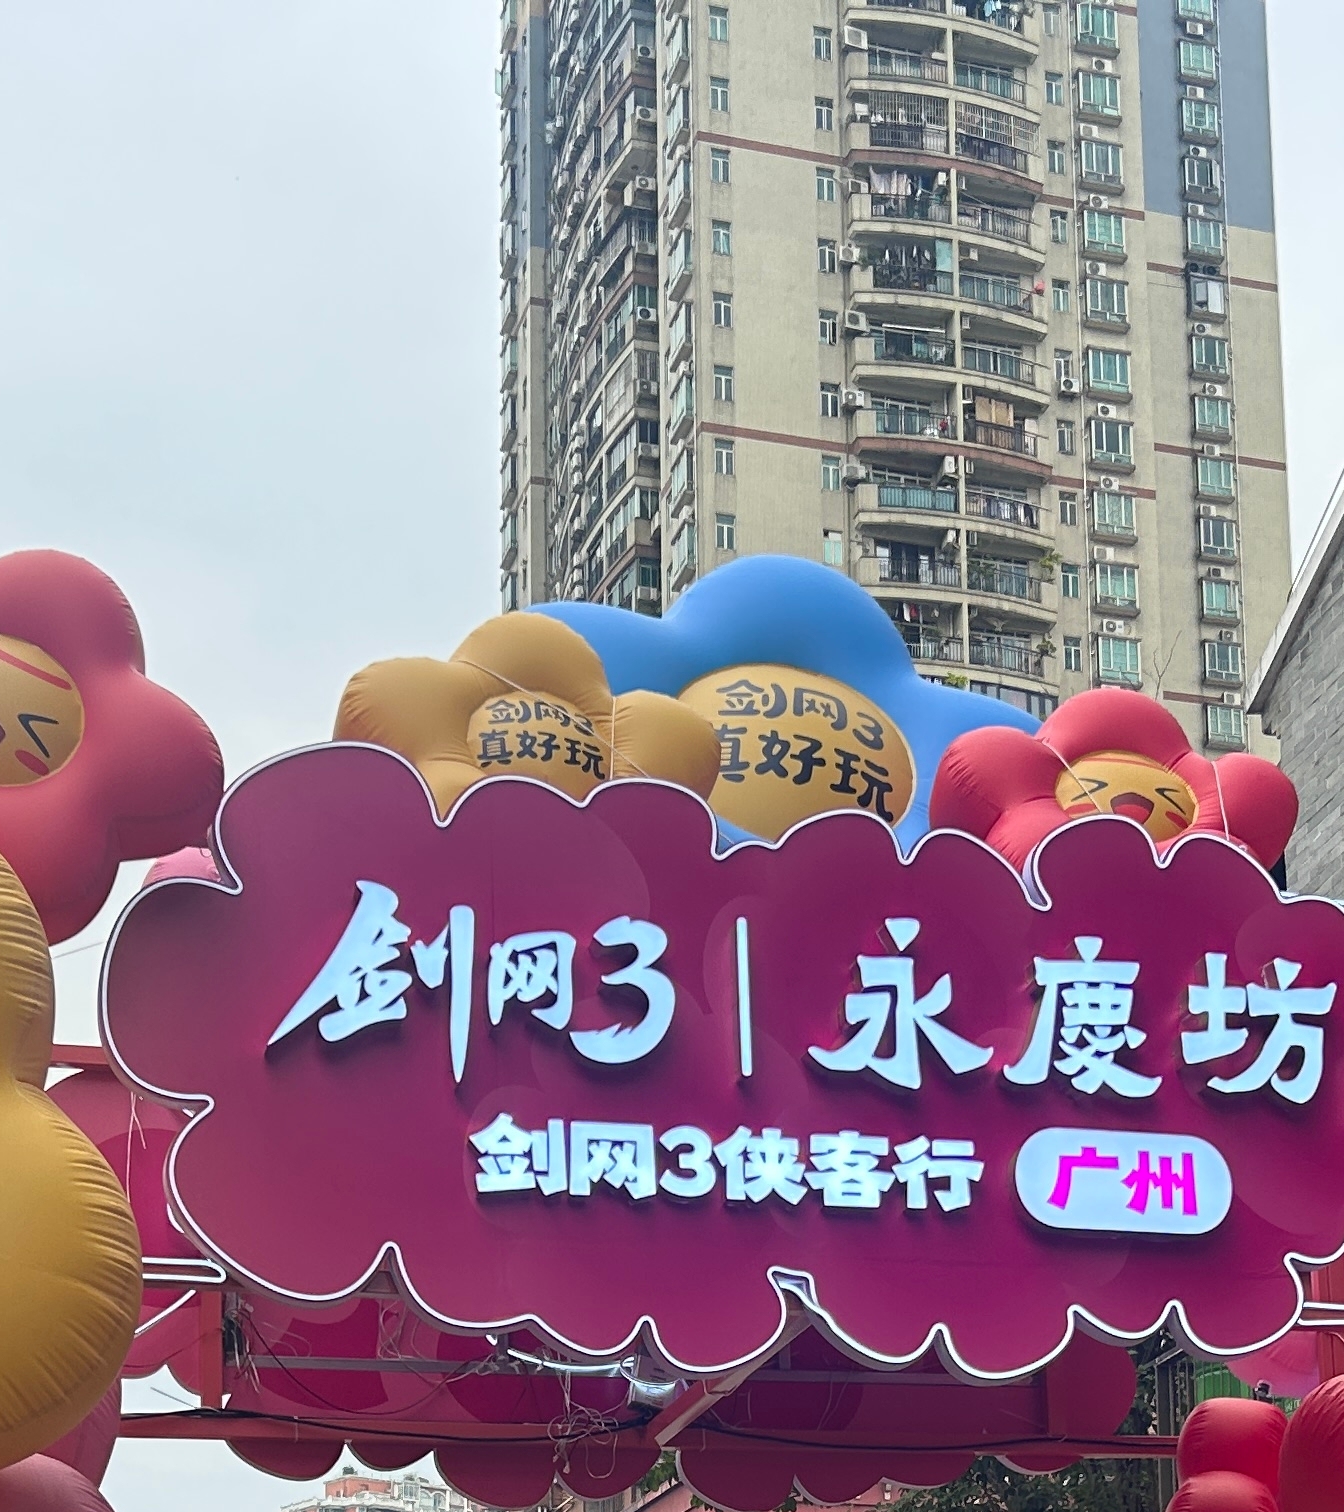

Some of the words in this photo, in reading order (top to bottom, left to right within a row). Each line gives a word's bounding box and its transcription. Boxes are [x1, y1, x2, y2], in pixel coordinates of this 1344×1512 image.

[485, 699, 598, 739] 剑网3
[714, 678, 885, 752] 剑网3
[477, 729, 606, 780] 真好玩
[265, 879, 676, 1083] 剑网3
[808, 916, 1338, 1105] 永慶坊
[468, 1111, 985, 1212] 剑网3侠客行
[1046, 1145, 1200, 1217] 广州
